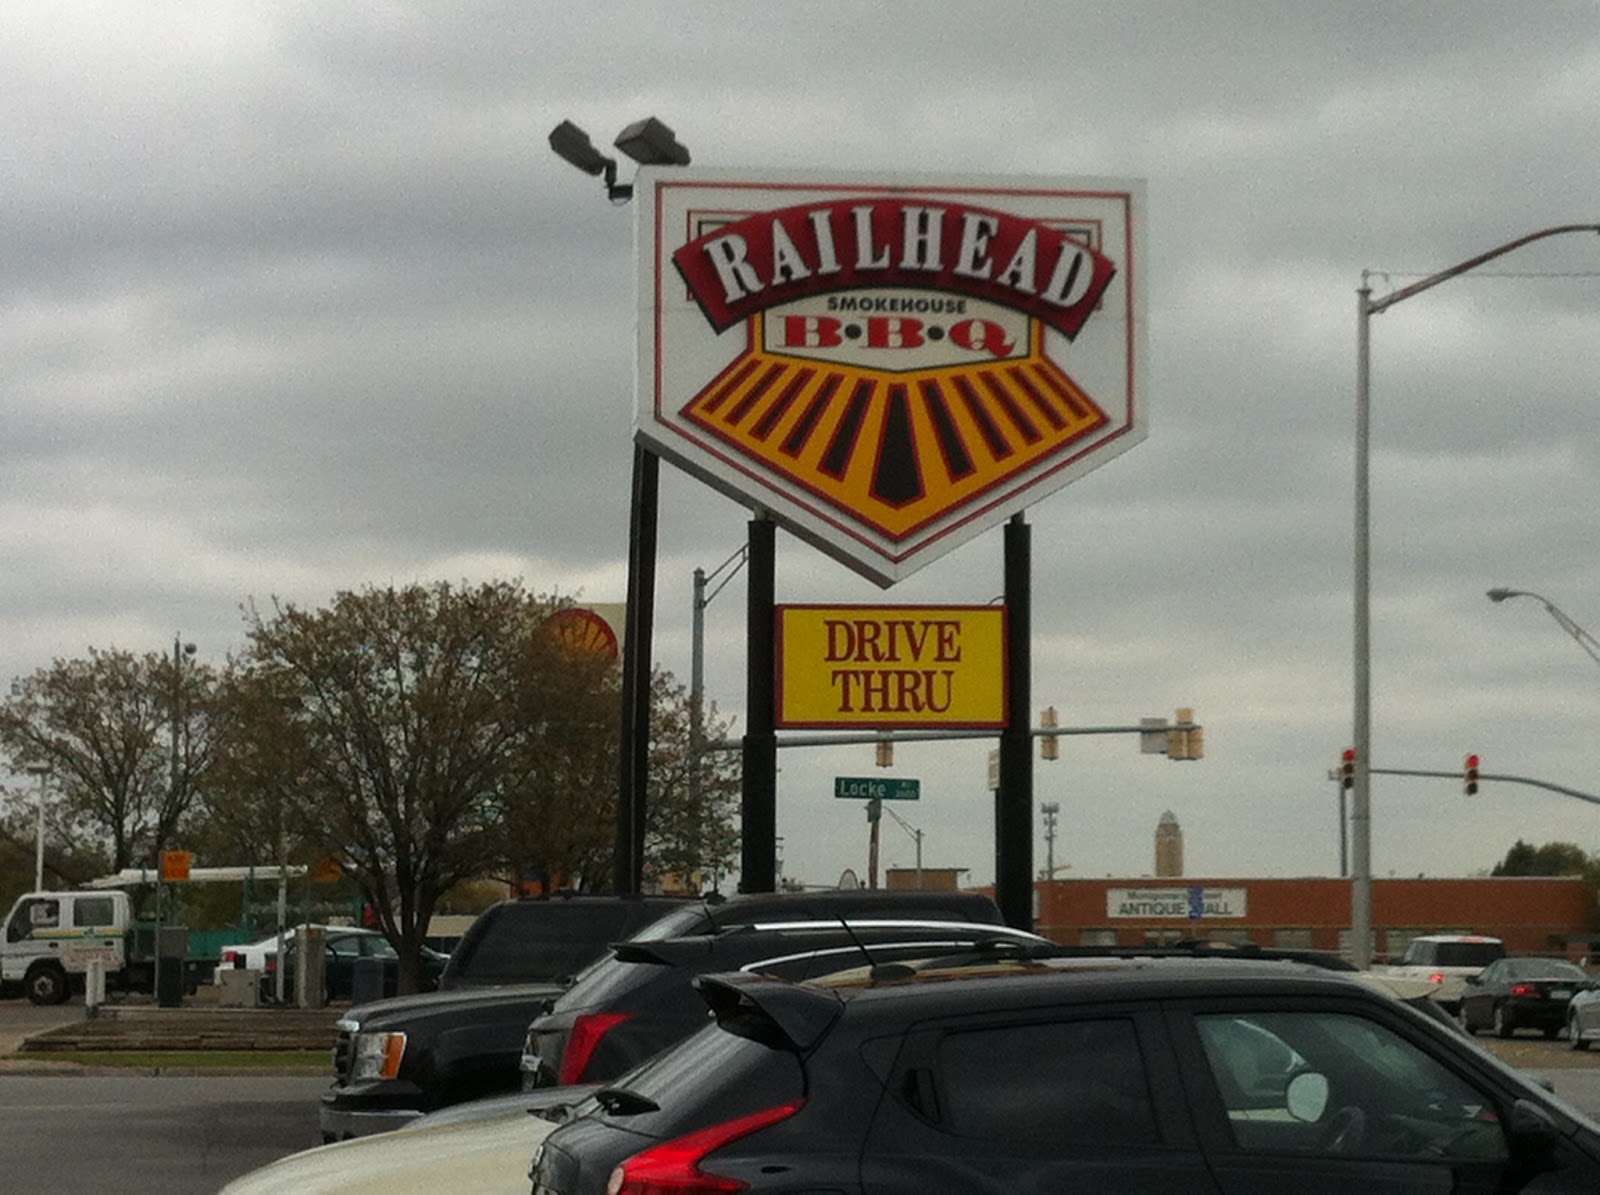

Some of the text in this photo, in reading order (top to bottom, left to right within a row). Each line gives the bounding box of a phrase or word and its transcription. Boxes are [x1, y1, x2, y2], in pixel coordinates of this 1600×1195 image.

[703, 205, 1095, 308] RAILHEAD
[827, 296, 967, 314] SMOKEHOUSE
[824, 620, 961, 662] DRIVE
[831, 669, 955, 713] THRU
[841, 780, 887, 797] Locke
[1119, 902, 1233, 915] ANTIQUE ALL
